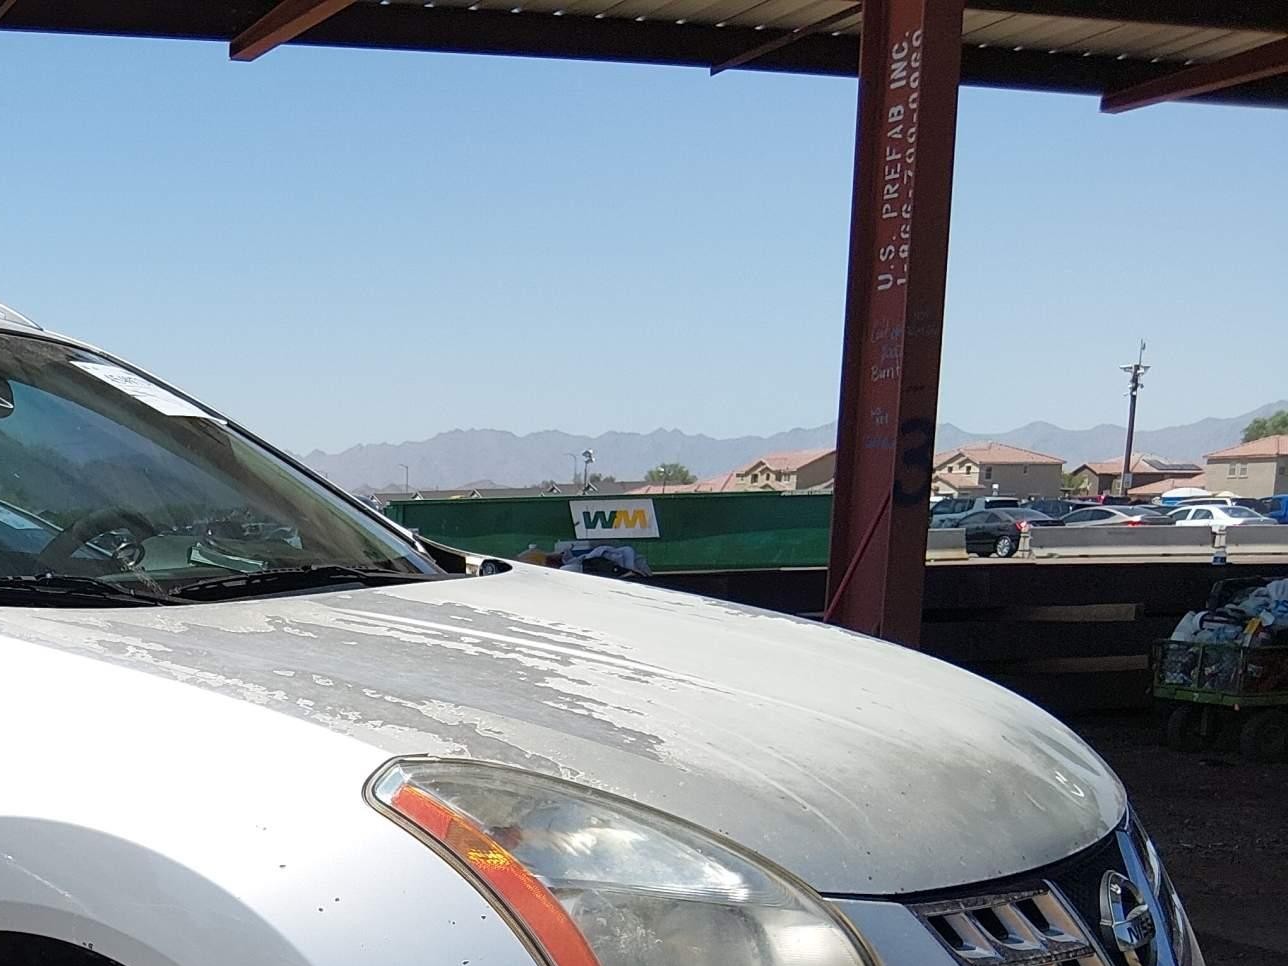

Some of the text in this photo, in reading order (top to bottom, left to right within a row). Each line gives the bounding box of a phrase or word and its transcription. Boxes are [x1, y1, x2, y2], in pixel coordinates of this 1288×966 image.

[890, 31, 910, 90] INC.
[882, 104, 905, 219] PREFAB
[582, 509, 647, 529] WM
